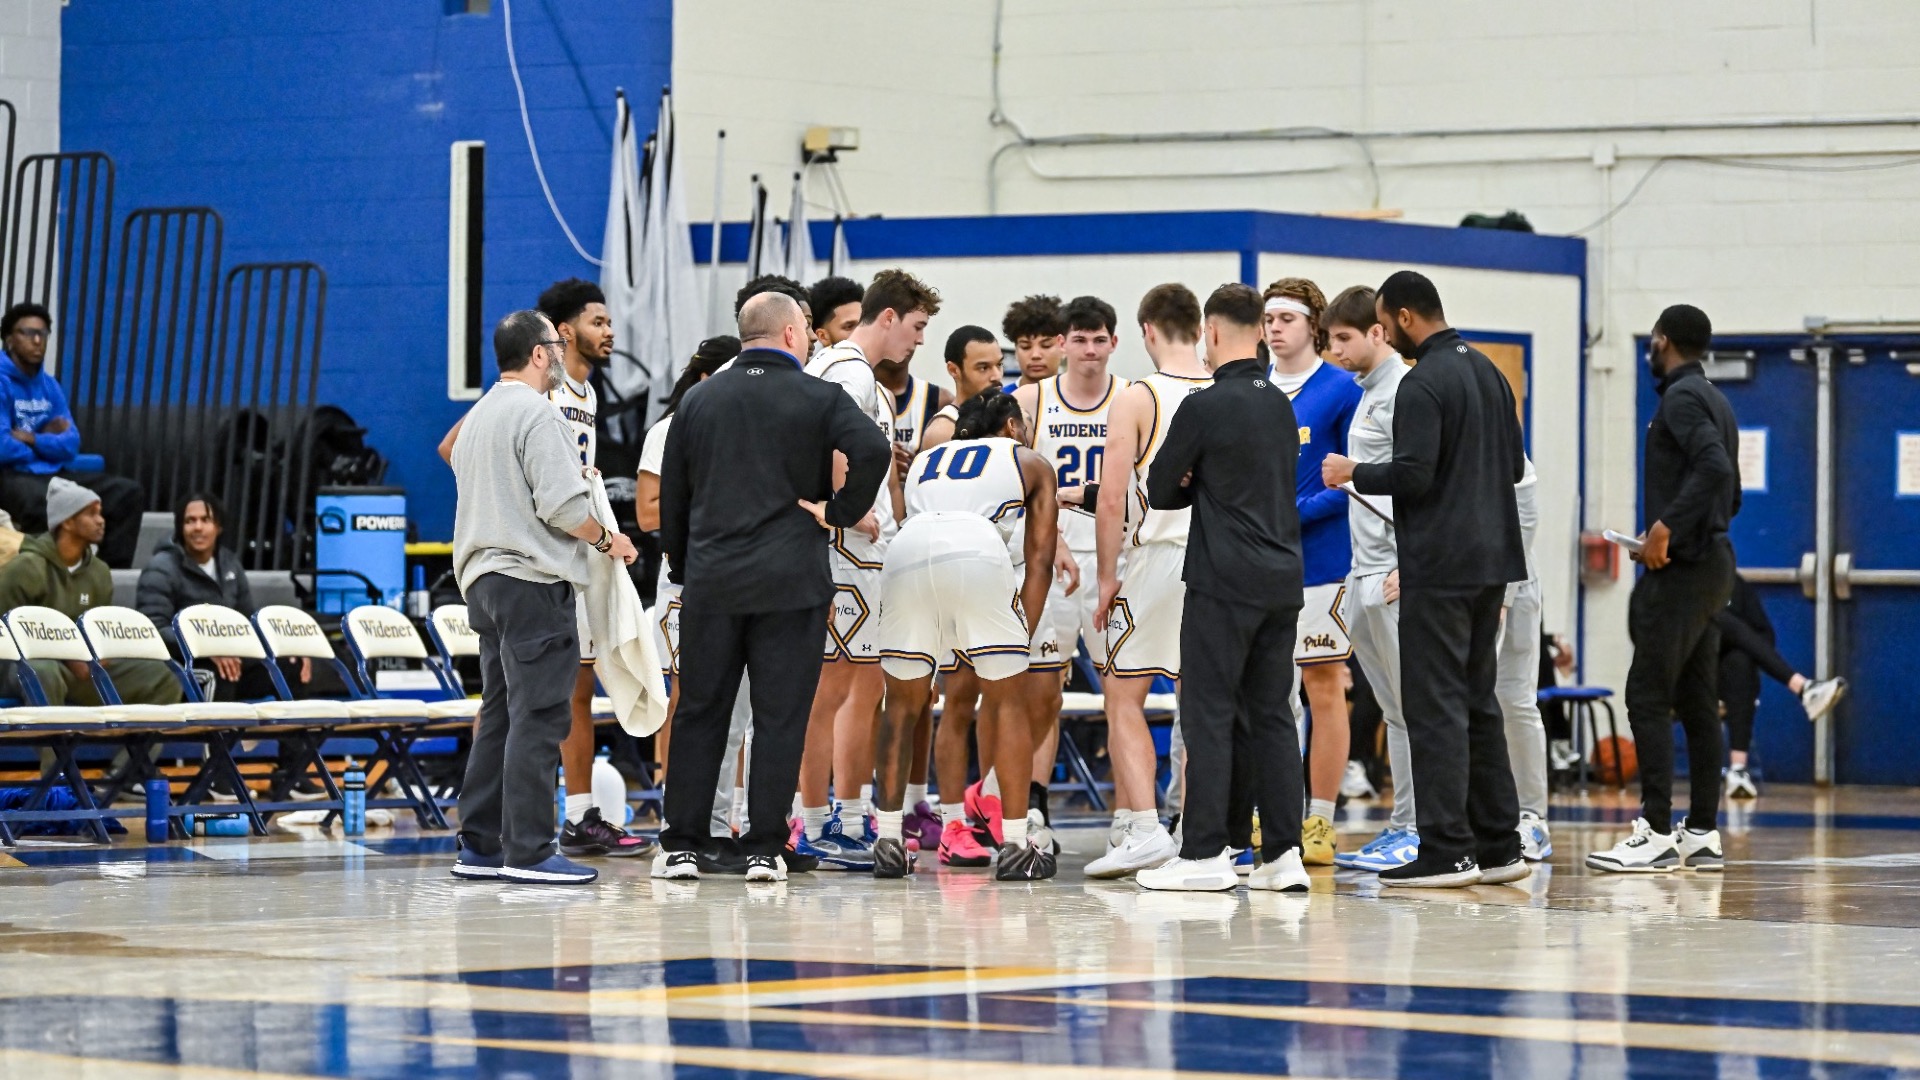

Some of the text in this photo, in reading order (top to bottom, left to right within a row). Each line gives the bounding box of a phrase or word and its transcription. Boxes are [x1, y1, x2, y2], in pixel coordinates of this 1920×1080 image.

[1049, 424, 1107, 437] WIDENE
[919, 444, 992, 485] 10
[1057, 445, 1105, 488] 20
[836, 605, 857, 616] 1/CL
[18, 620, 78, 641] Widener
[94, 620, 156, 640] Widener
[189, 618, 251, 637] Widener
[267, 618, 319, 637] Widener
[359, 618, 413, 638] Widener
[1303, 633, 1337, 652] Pride
